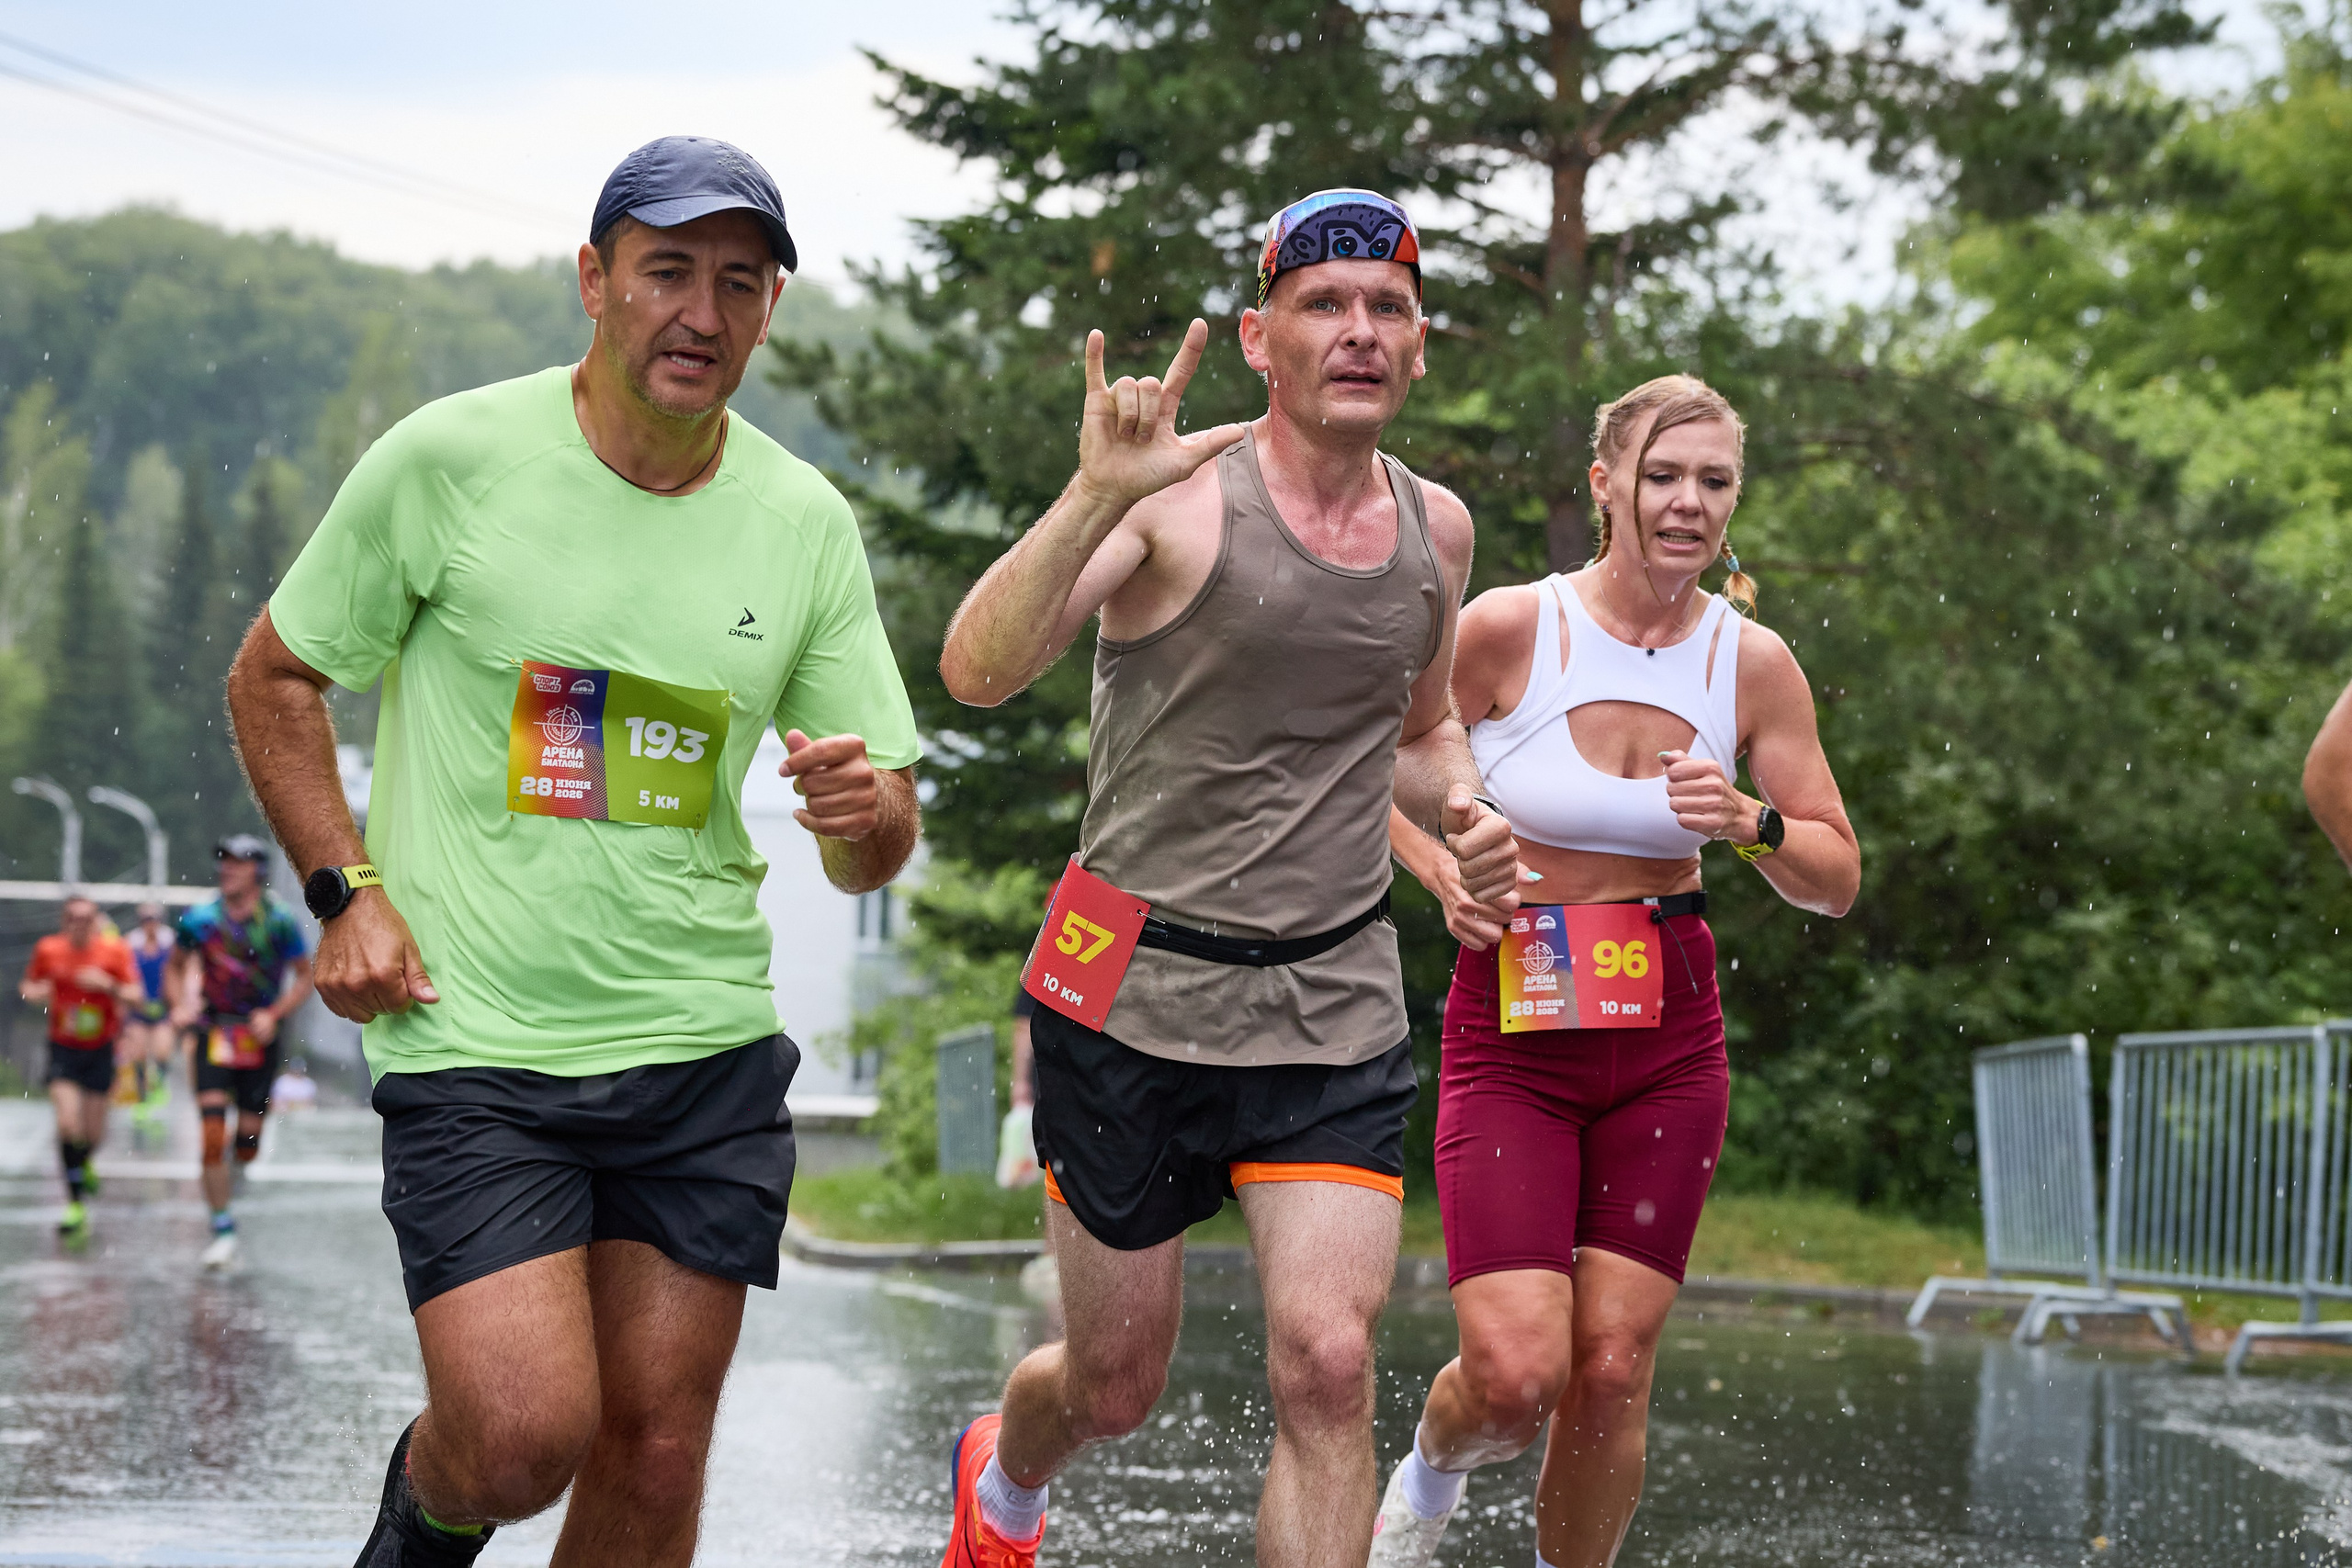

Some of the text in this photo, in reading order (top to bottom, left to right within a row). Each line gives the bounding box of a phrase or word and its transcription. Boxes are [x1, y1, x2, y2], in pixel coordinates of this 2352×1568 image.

[729, 628, 764, 641] DEMIX
[625, 716, 710, 763] 193
[542, 745, 584, 761] АРЕНА
[541, 758, 584, 769] БИАТЛОНА
[519, 775, 553, 796] 28
[555, 778, 592, 790] ИЮНЯ
[638, 789, 650, 807] 5
[1055, 909, 1116, 964] 57
[1592, 940, 1649, 979] 96
[1042, 973, 1059, 992] 10
[1523, 974, 1557, 986] АРЕНА
[1510, 999, 1534, 1017] 28
[1599, 1000, 1618, 1015] 10
